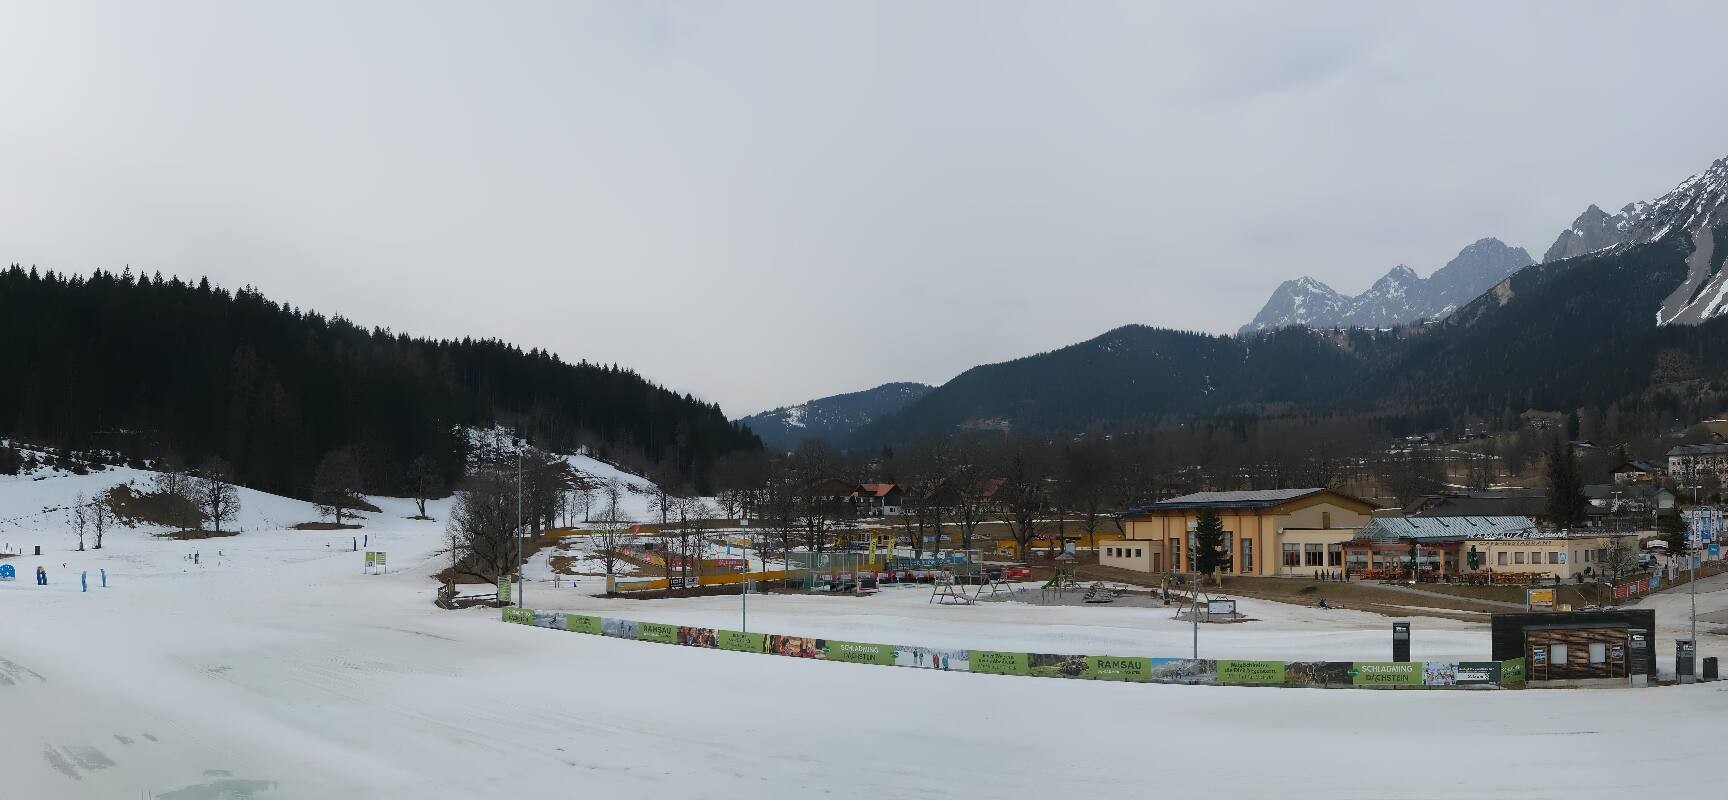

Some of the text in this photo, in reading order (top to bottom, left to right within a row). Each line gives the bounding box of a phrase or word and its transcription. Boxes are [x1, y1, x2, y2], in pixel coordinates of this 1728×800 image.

[643, 625, 671, 634] RAMSAU
[1097, 660, 1142, 669] RAMSAU
[1361, 665, 1413, 673] SCHLADMING
